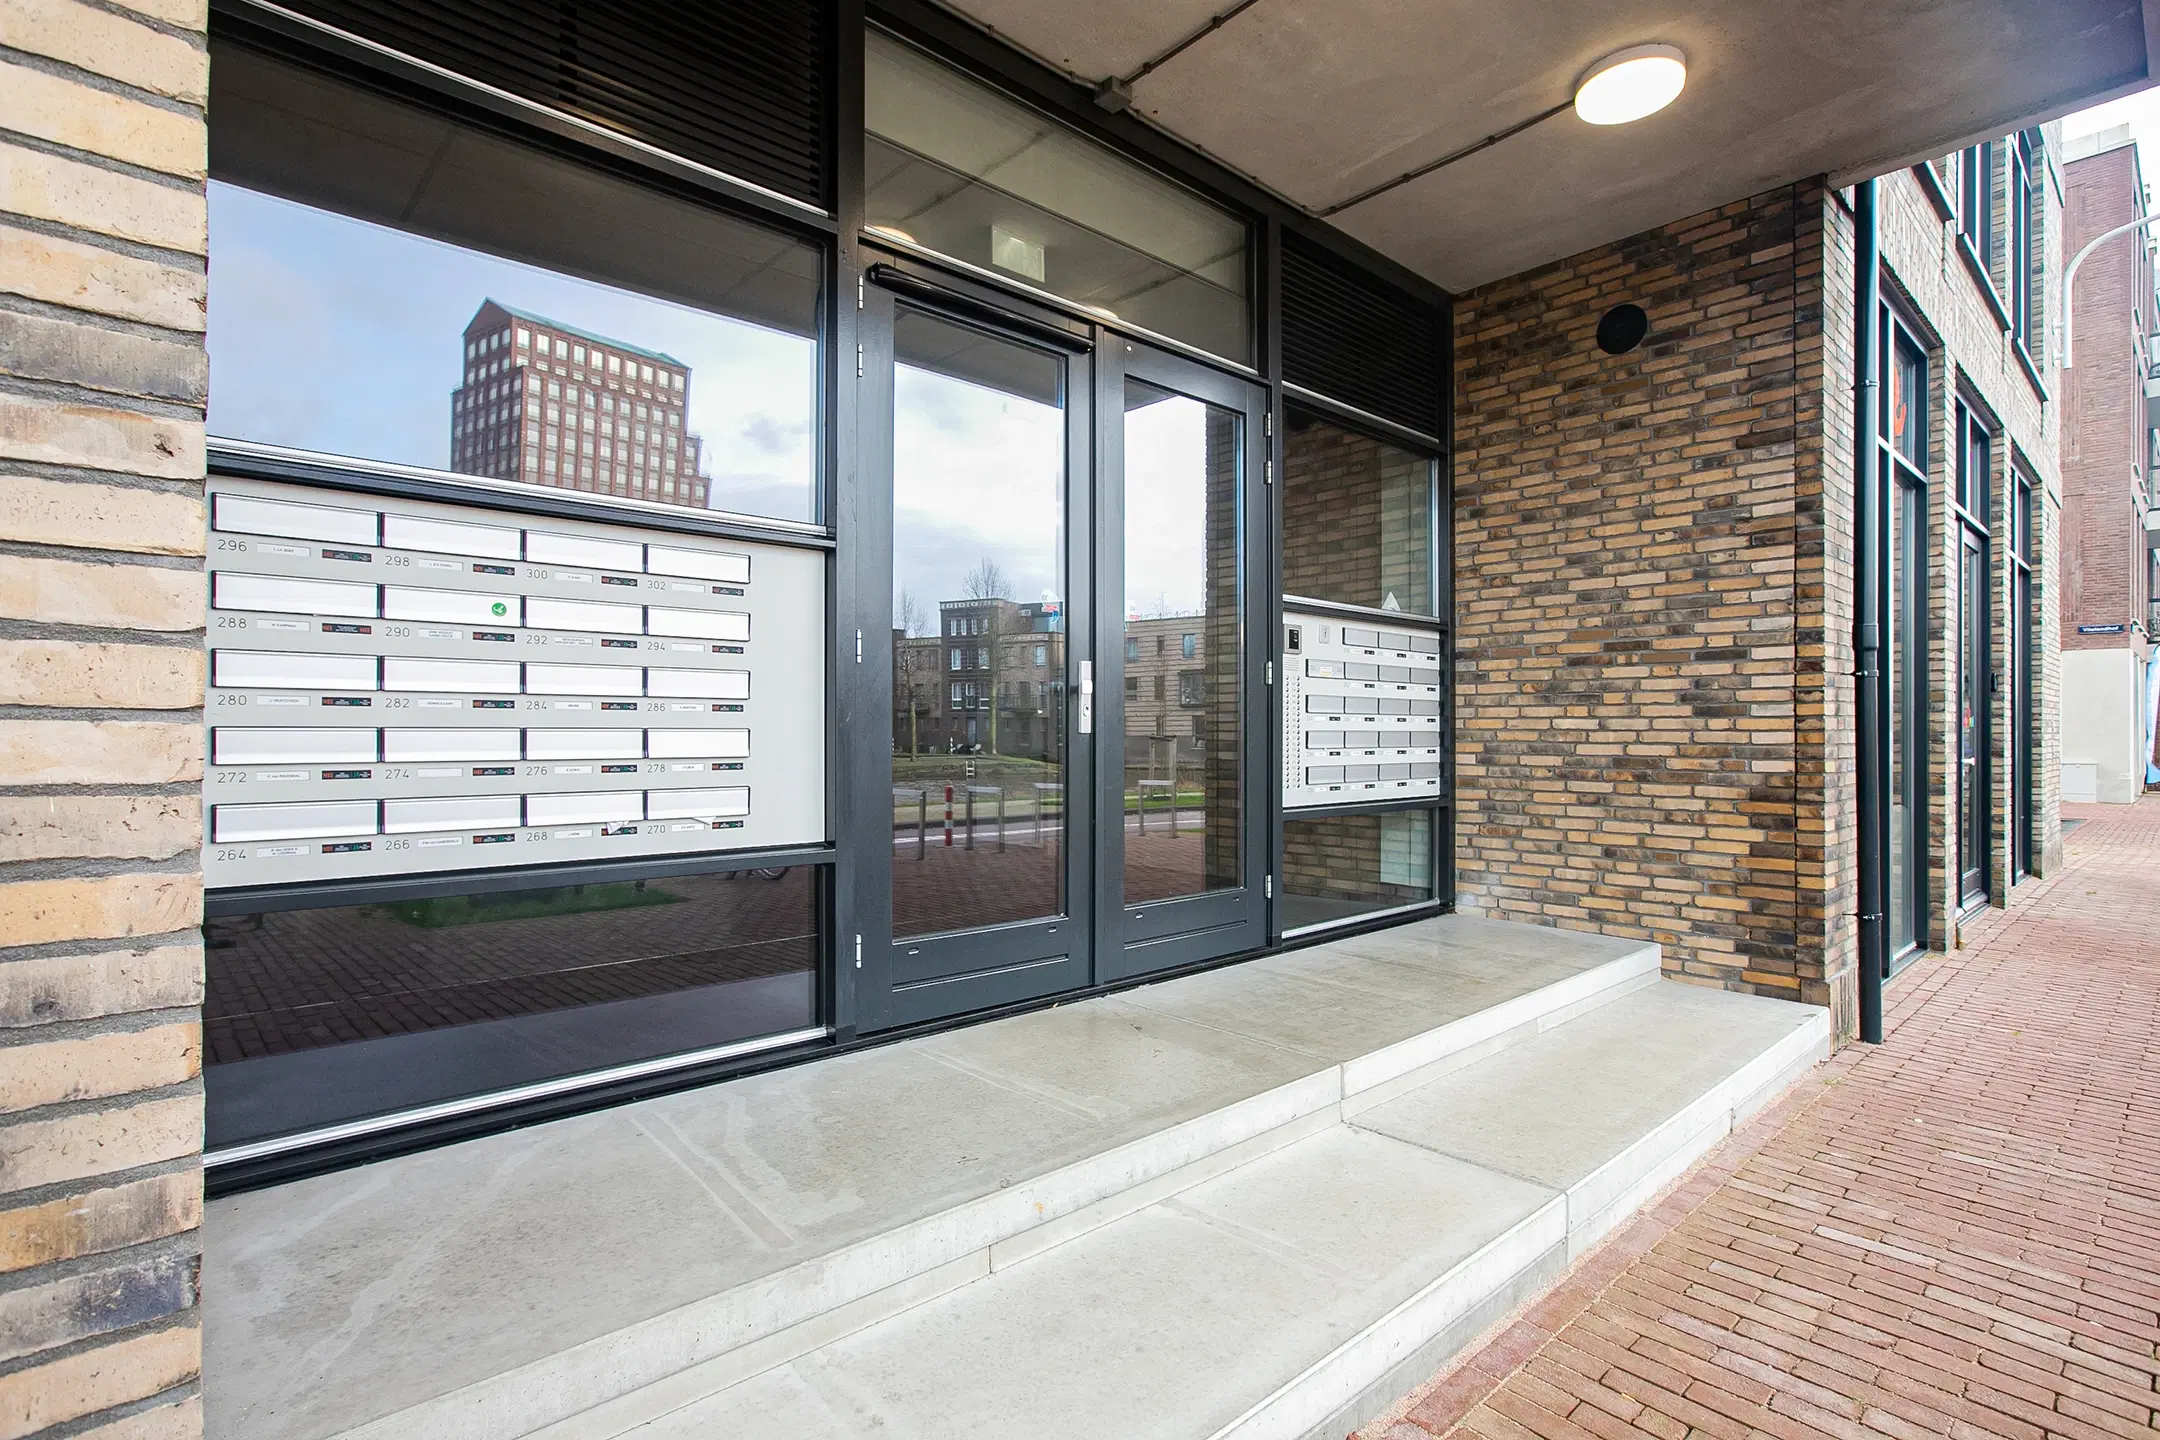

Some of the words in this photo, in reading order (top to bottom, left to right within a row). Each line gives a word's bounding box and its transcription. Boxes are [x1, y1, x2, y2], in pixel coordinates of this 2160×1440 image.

[217, 538, 248, 553] 296
[385, 555, 411, 567] 298
[526, 568, 548, 580] 300
[647, 580, 666, 590] 302
[217, 616, 247, 629] 288
[385, 626, 411, 638] 290
[526, 634, 548, 645] 292
[647, 641, 666, 651] 294
[217, 694, 247, 706] 280
[385, 697, 410, 709] 282
[526, 700, 547, 711] 284
[647, 702, 666, 712] 286
[385, 768, 410, 780] 274
[526, 766, 548, 777] 276
[647, 764, 666, 774] 278
[217, 771, 247, 784] 272
[647, 825, 666, 835] 270
[526, 832, 548, 843] 268
[385, 839, 410, 851] 266
[217, 849, 247, 862] 264
